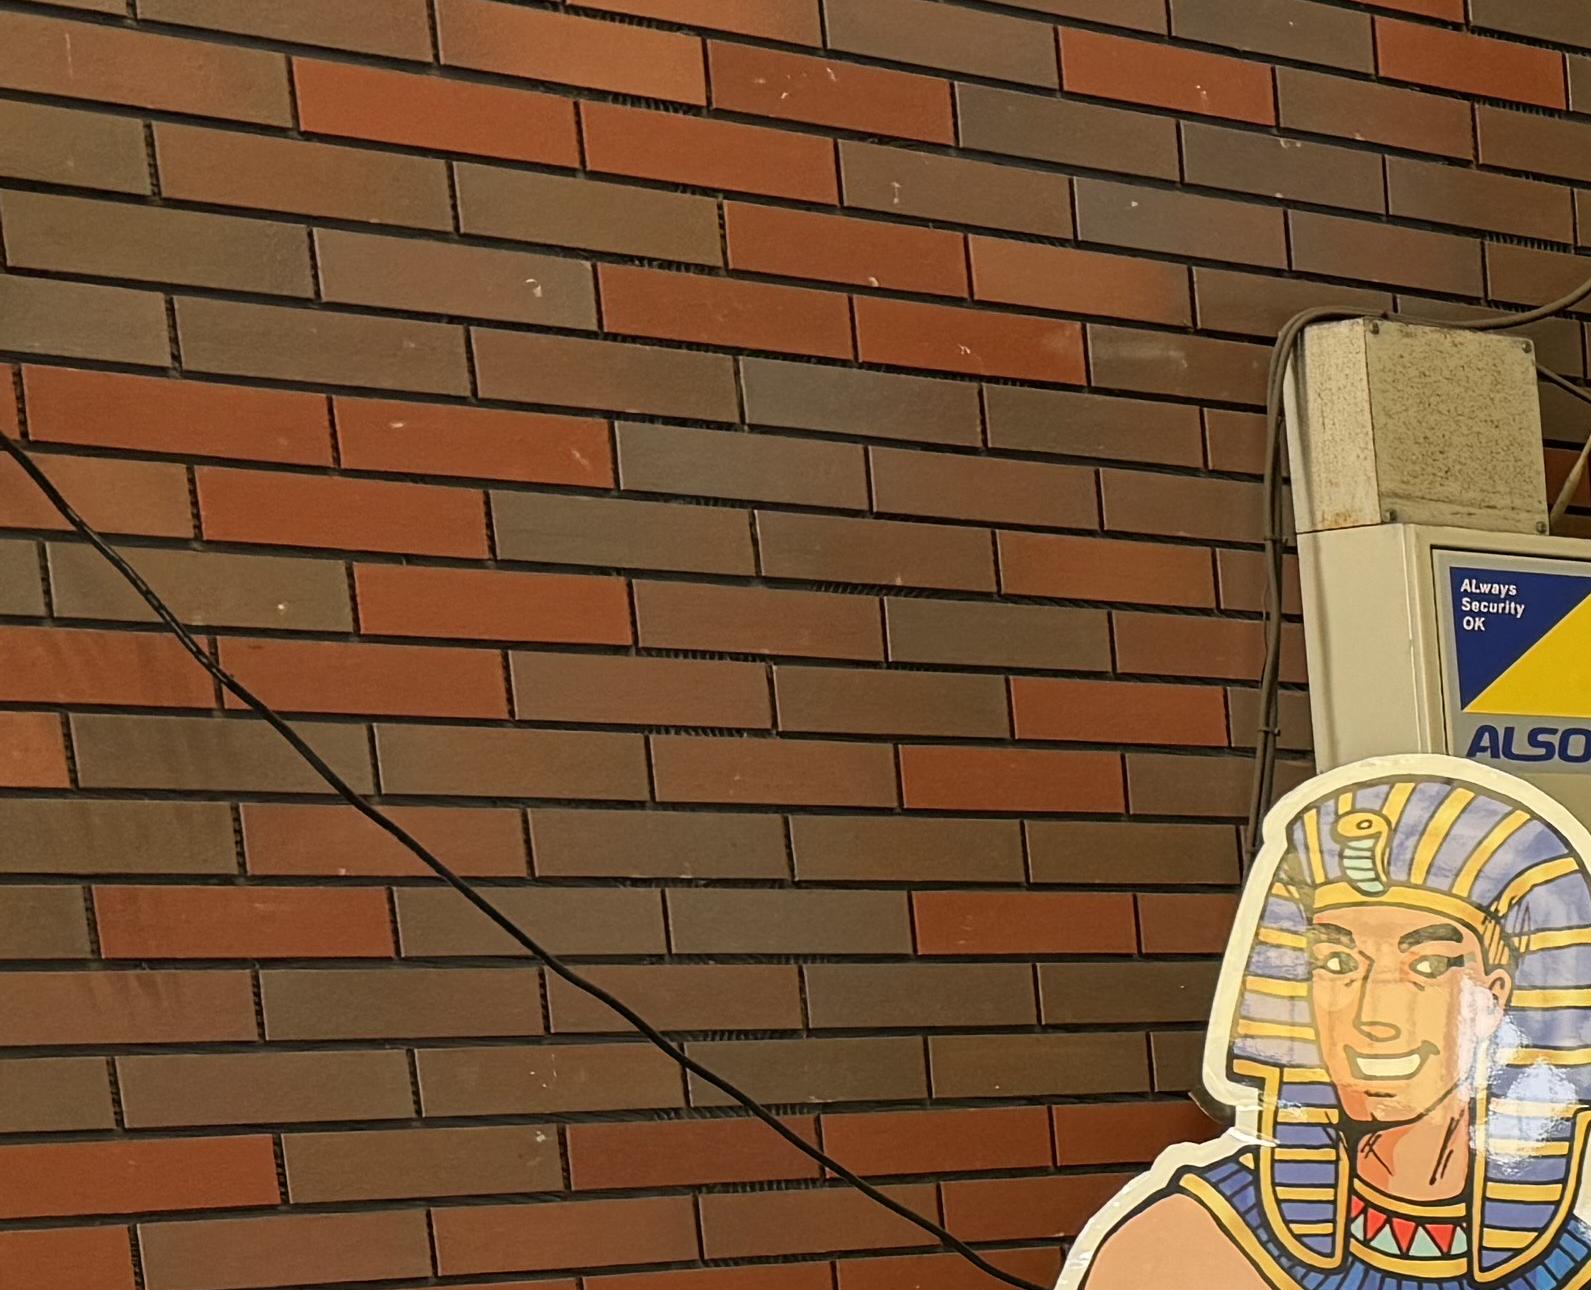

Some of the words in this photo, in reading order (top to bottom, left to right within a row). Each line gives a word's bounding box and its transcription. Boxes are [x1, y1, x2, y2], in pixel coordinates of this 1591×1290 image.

[1460, 578, 1518, 599] ALways
[1461, 597, 1525, 618] Security
[1463, 615, 1486, 631] OK
